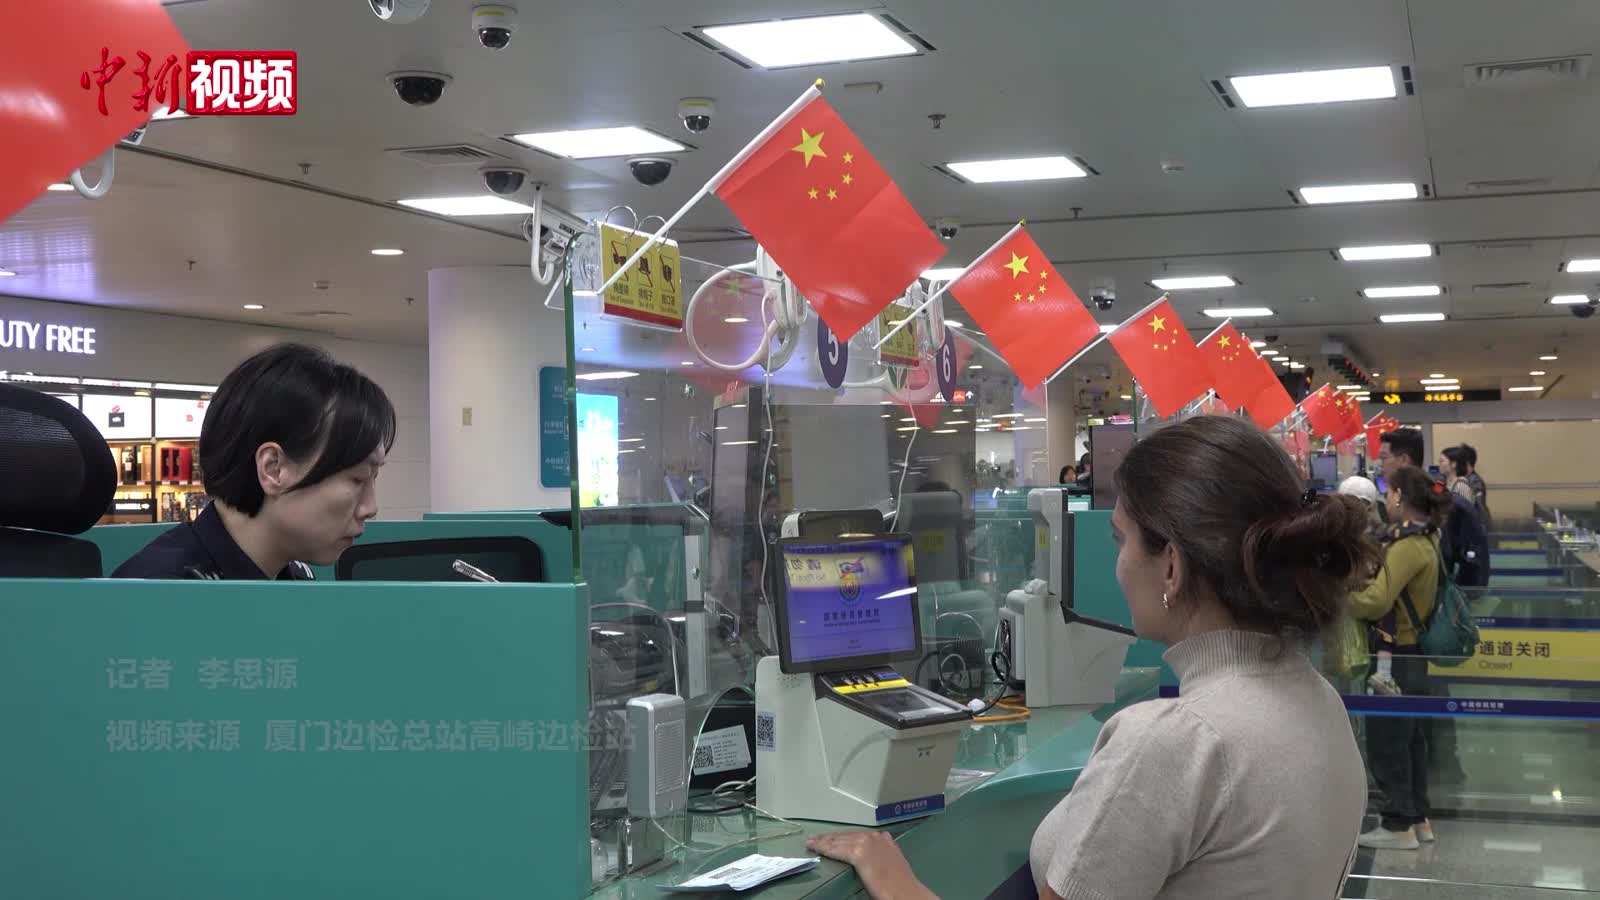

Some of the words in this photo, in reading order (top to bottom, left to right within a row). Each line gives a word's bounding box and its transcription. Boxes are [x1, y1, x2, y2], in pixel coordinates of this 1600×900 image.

[45, 324, 96, 354] FREE
[828, 328, 839, 366] 5
[942, 344, 951, 383] 6
[1479, 640, 1551, 658] 通道关闭
